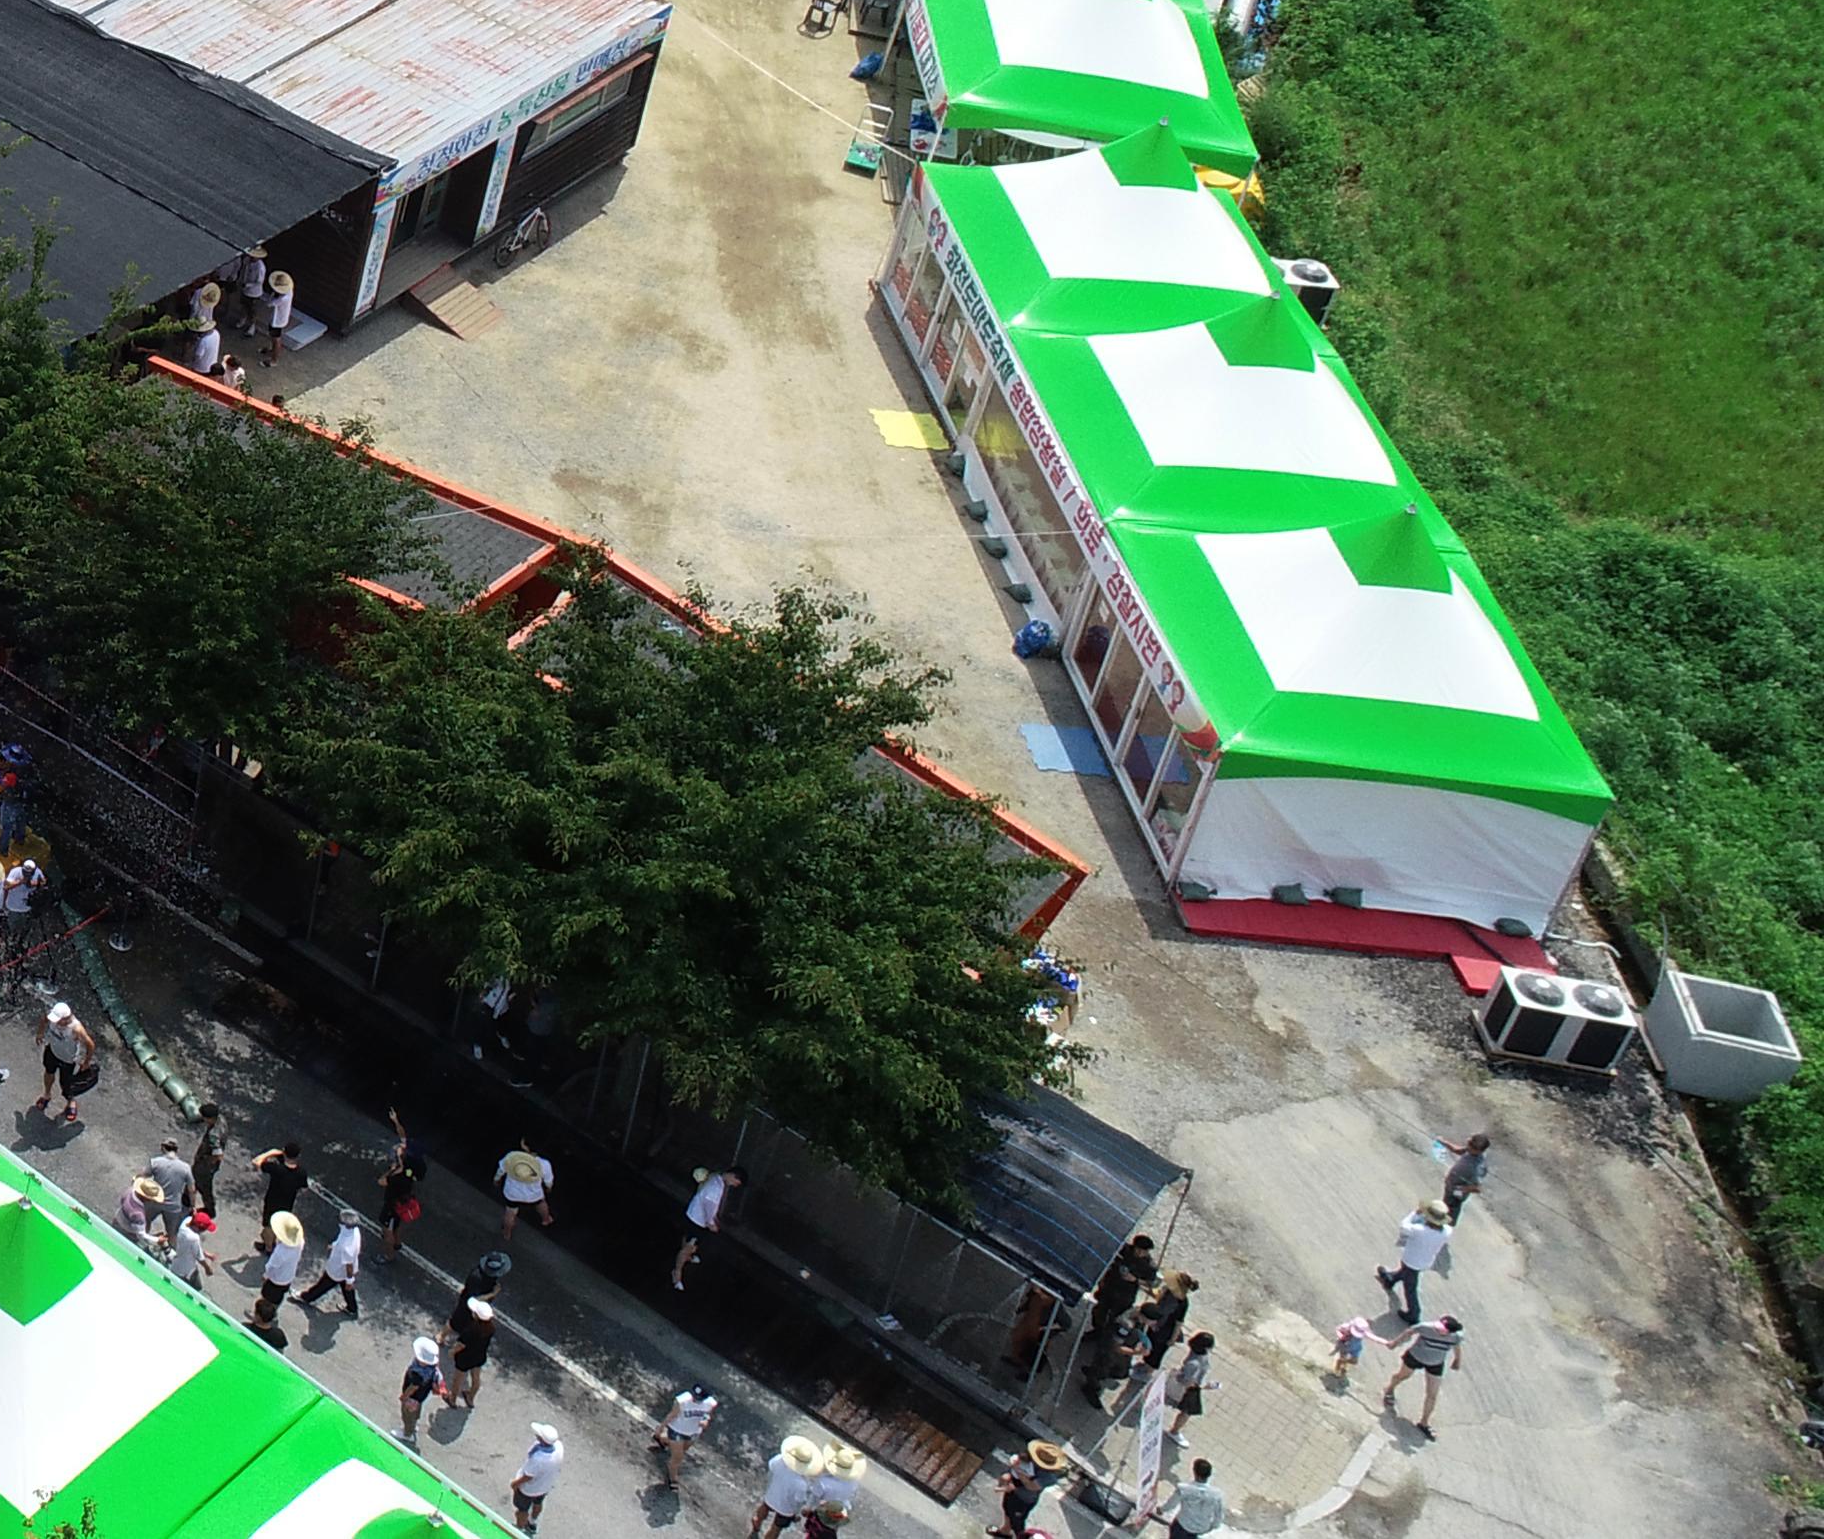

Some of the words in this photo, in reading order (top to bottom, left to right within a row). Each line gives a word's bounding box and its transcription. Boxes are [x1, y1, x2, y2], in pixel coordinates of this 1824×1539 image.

[418, 117, 492, 179] 청정화천
[496, 72, 571, 133] 농특산물
[575, 35, 629, 84] 판매장
[944, 243, 1017, 387] 화천토마토축제
[1008, 379, 1068, 490] 종합상황실
